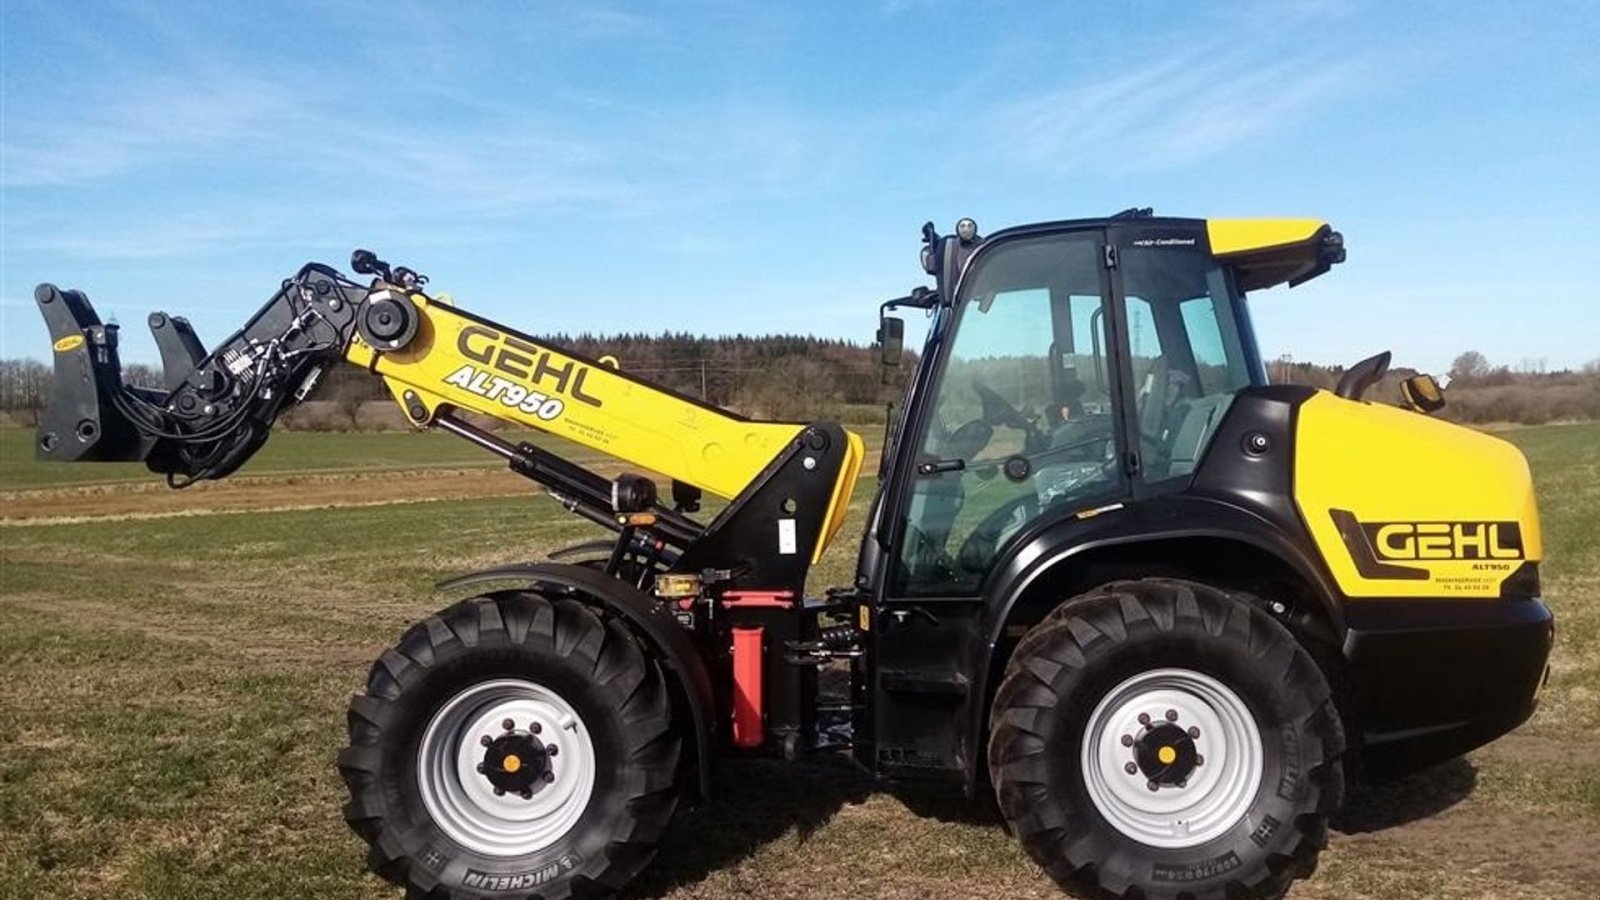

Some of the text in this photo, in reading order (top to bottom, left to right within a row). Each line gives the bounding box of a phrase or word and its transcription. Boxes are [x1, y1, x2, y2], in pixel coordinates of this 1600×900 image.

[457, 325, 603, 408] GEHL
[442, 364, 566, 422] ALT950
[1376, 523, 1520, 559] GEHL
[1472, 563, 1511, 571] ALT950
[464, 864, 559, 890] MICHELIN
